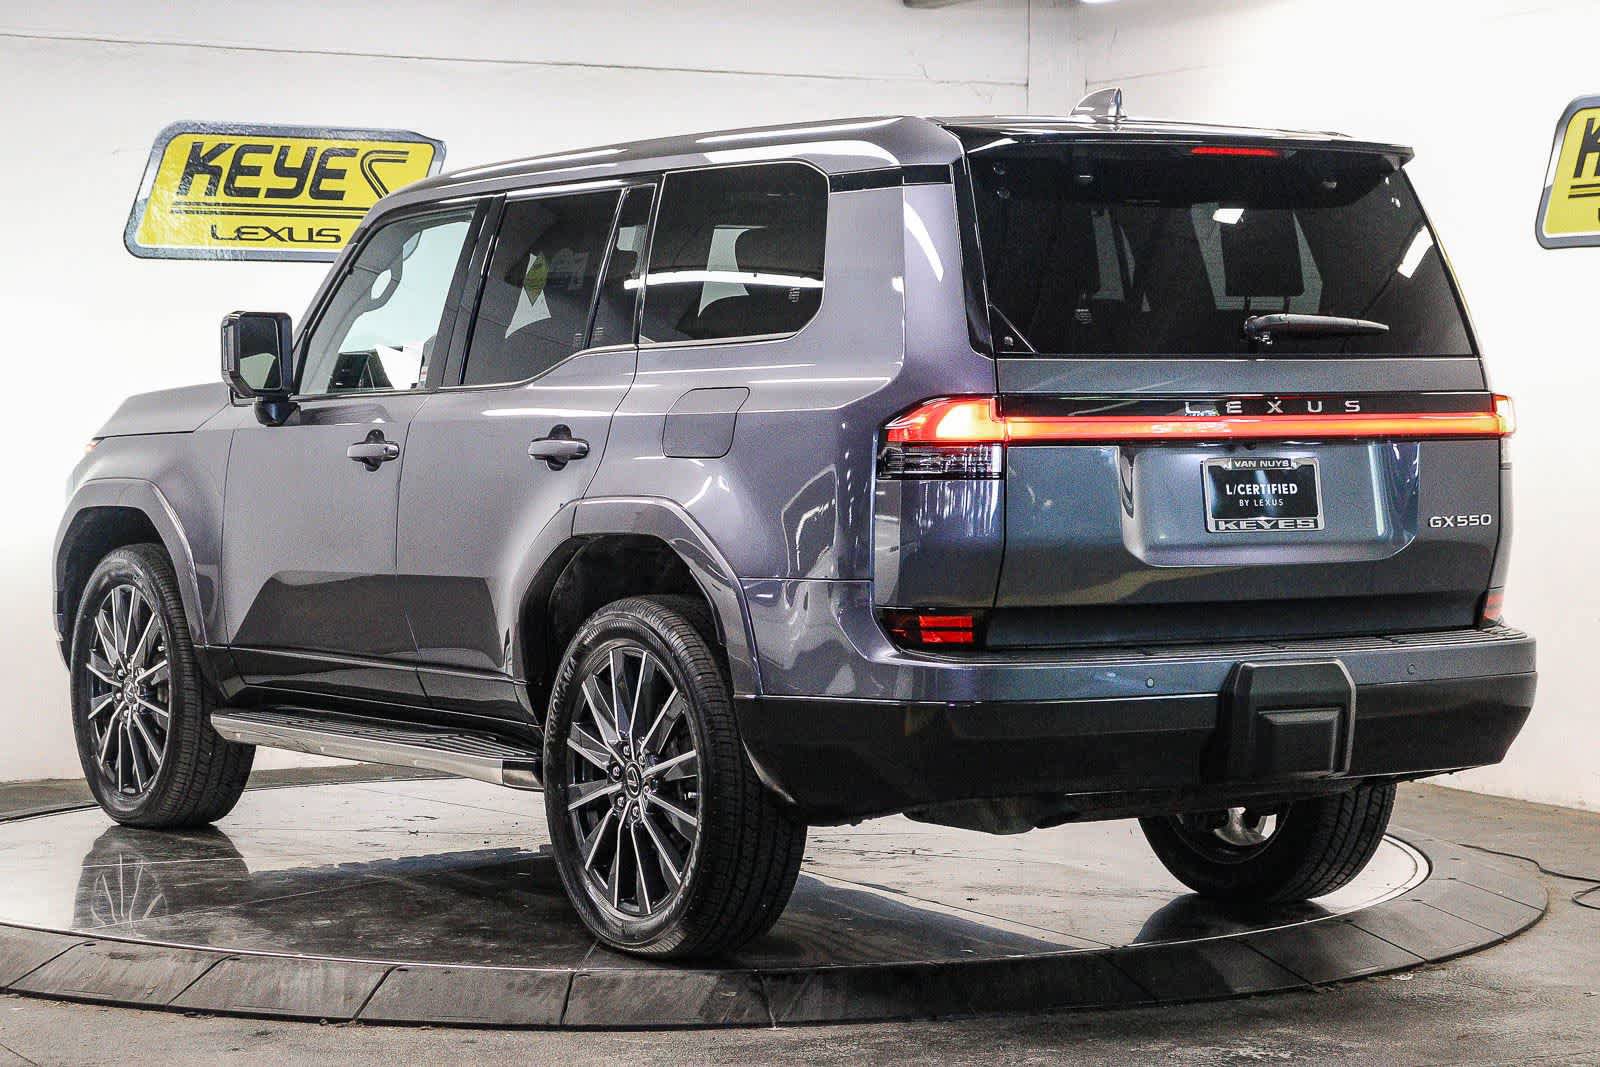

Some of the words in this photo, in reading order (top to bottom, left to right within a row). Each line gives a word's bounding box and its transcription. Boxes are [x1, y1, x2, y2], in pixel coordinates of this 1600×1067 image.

[211, 224, 342, 244] LEXUS
[1184, 400, 1361, 414] LEXUS
[1234, 459, 1257, 468] VAN
[1260, 459, 1290, 468] NUYS
[1226, 483, 1298, 495] L/CERTIFIED
[1239, 498, 1250, 507] BY
[1253, 498, 1285, 507] LEXUS
[1218, 518, 1315, 531] KEYES
